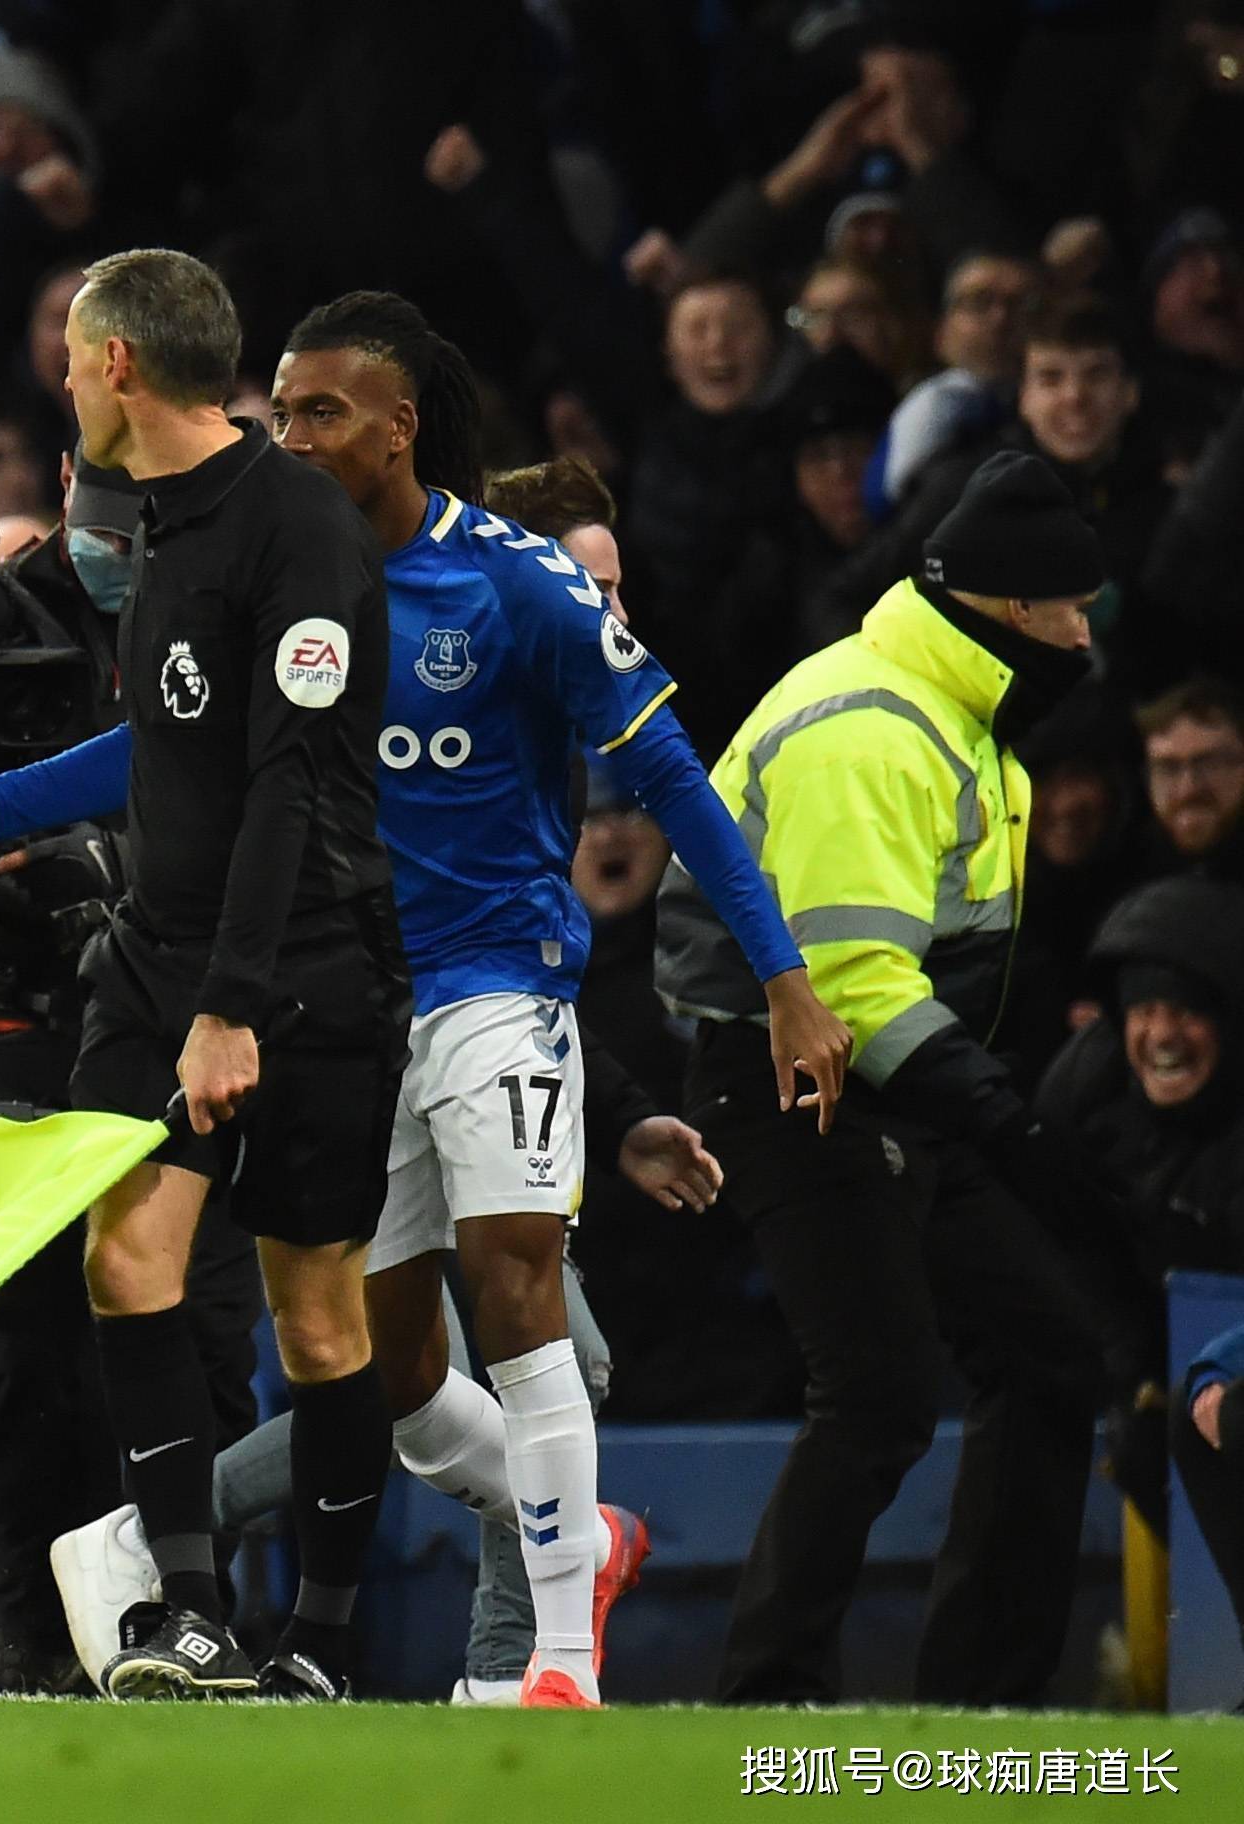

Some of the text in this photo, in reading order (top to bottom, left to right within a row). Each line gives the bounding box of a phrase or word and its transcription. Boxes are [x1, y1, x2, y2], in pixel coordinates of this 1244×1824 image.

[290, 638, 342, 671] EA
[429, 661, 461, 672] Everton
[286, 667, 342, 687] SPORTS
[498, 1074, 563, 1152] 17
